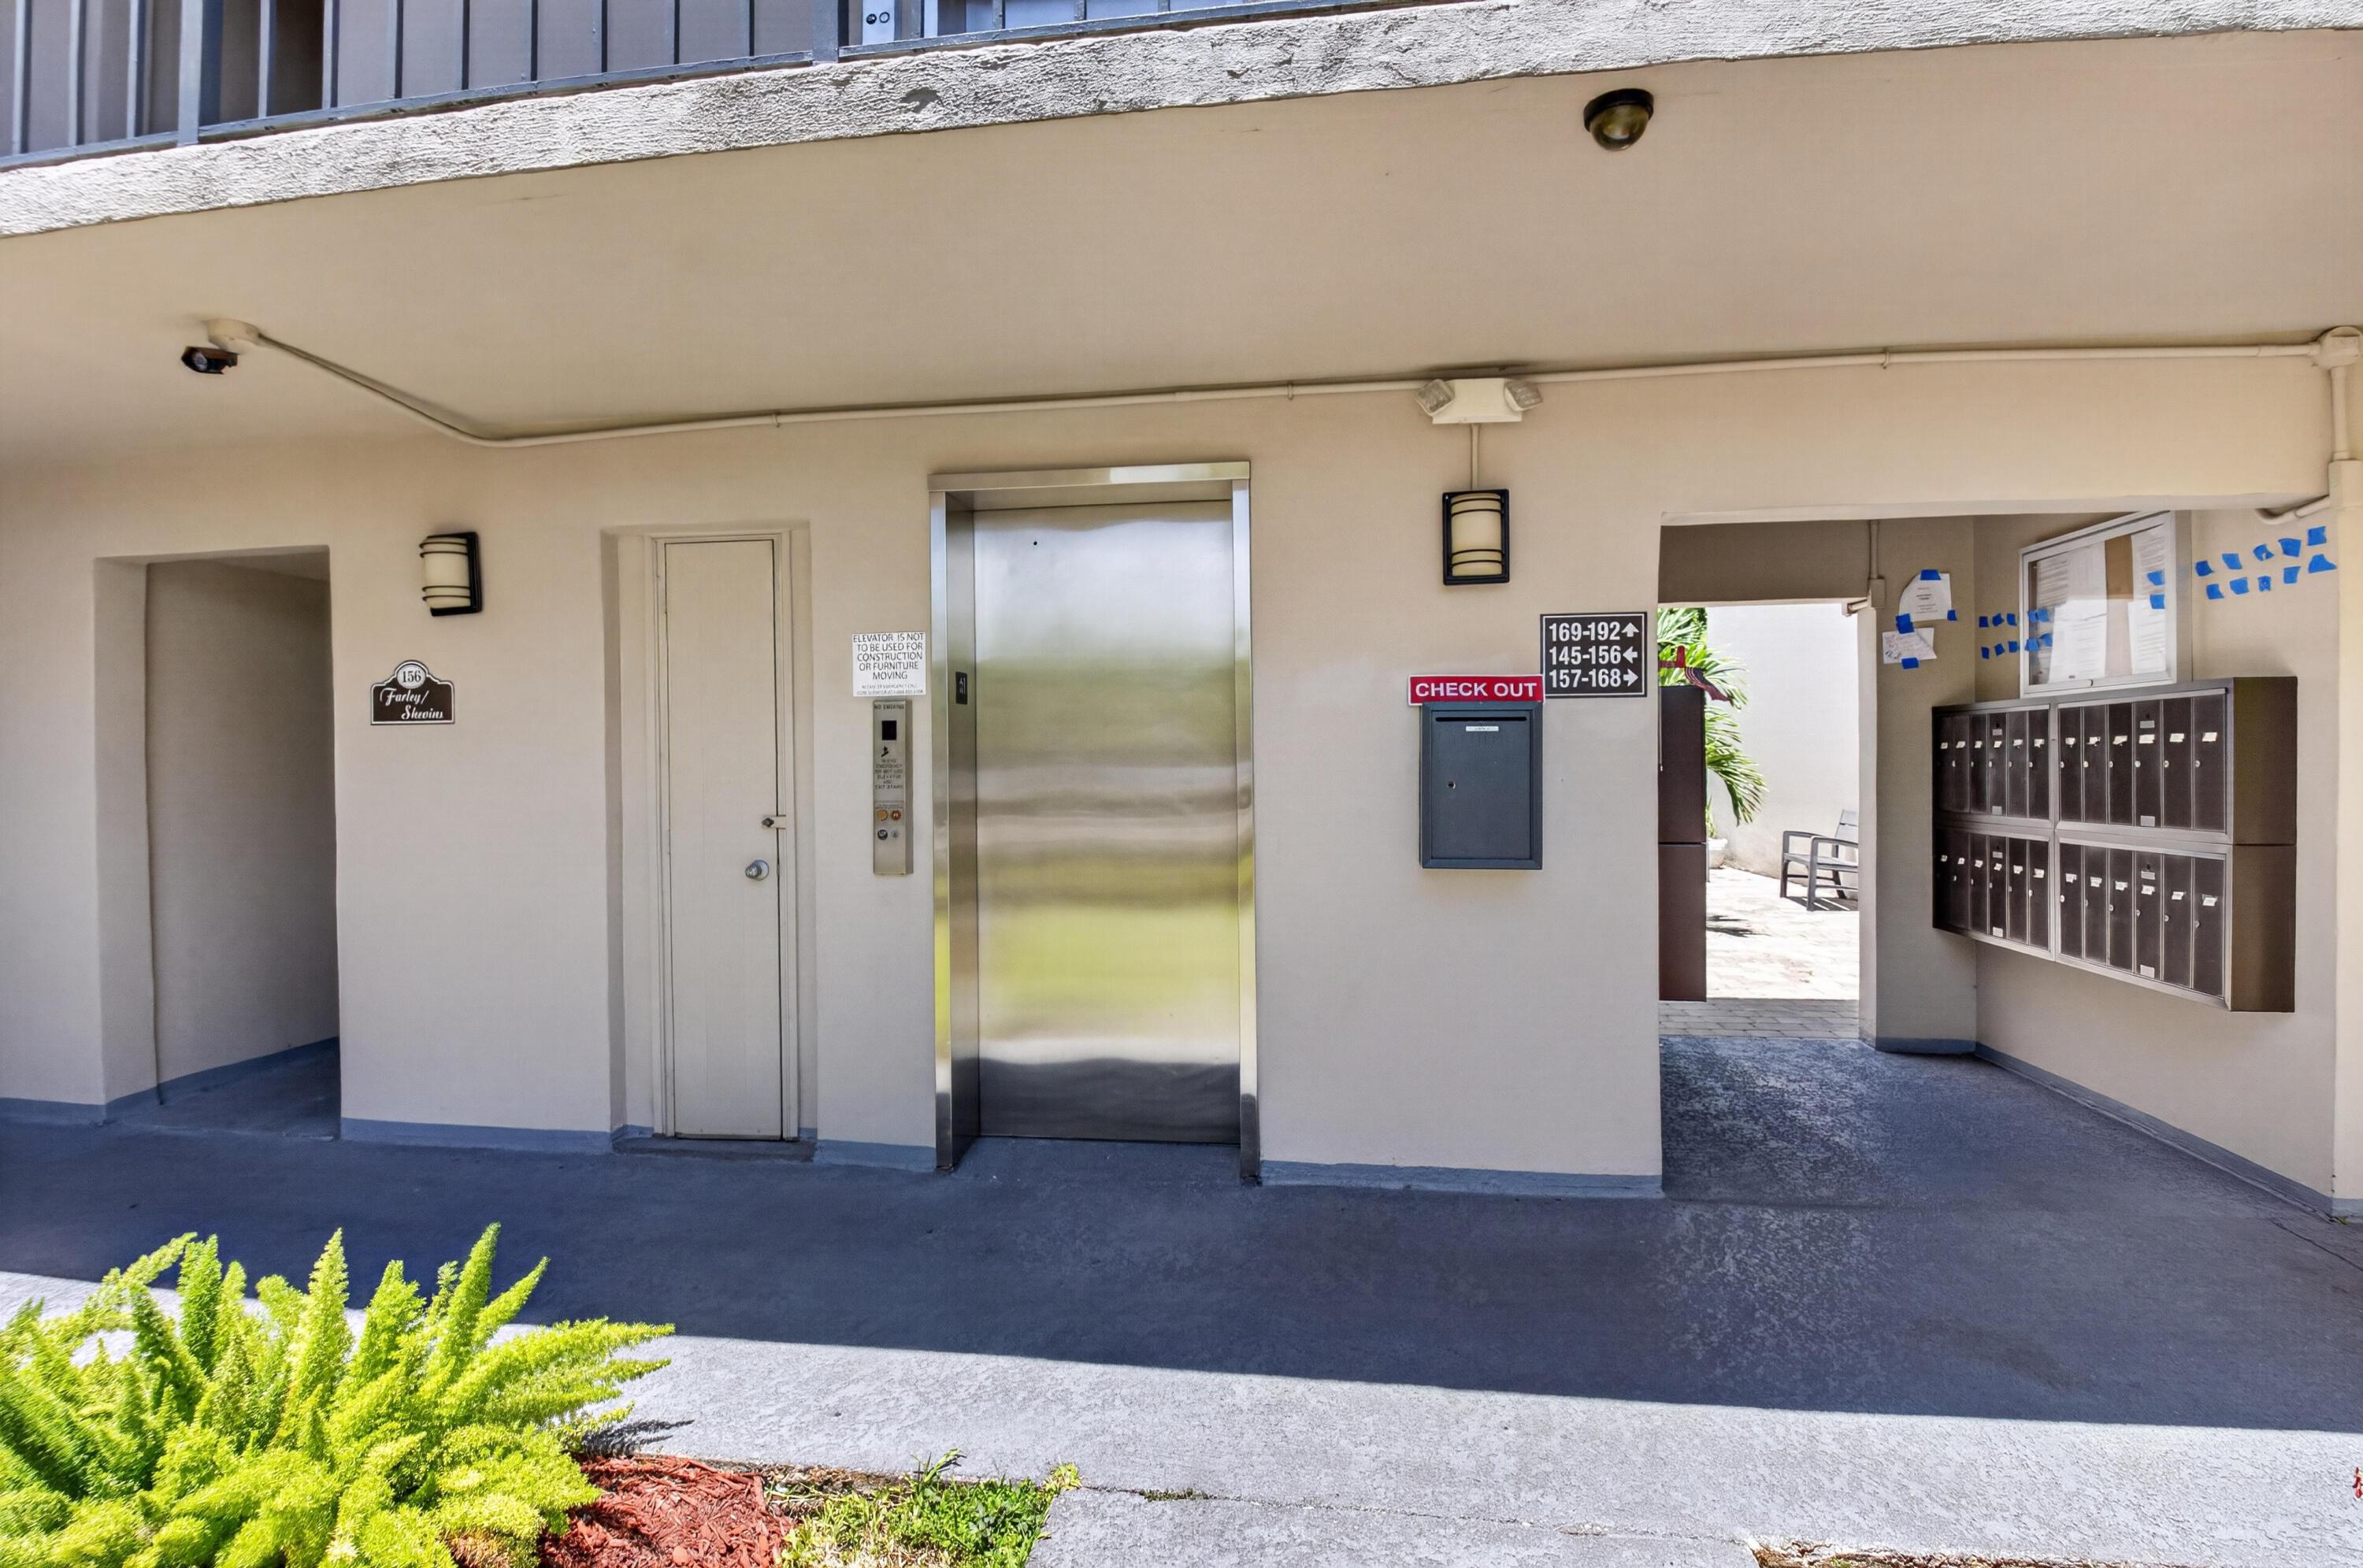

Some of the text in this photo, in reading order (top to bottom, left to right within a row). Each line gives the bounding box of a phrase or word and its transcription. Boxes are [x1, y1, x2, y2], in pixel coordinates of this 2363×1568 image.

[853, 632, 924, 643] ELEVATOR IS NOT
[1549, 621, 1620, 642] 169-192
[857, 642, 923, 652] TO BE USED FOR
[857, 652, 922, 662] CONSTRUCTION
[1549, 645, 1621, 665] 145-156
[859, 662, 918, 671] OR FURNITURE
[402, 670, 421, 683] 156
[873, 671, 907, 680] MOVING
[1549, 669, 1621, 688] 157-168
[1415, 682, 1538, 697] CHECK OUT
